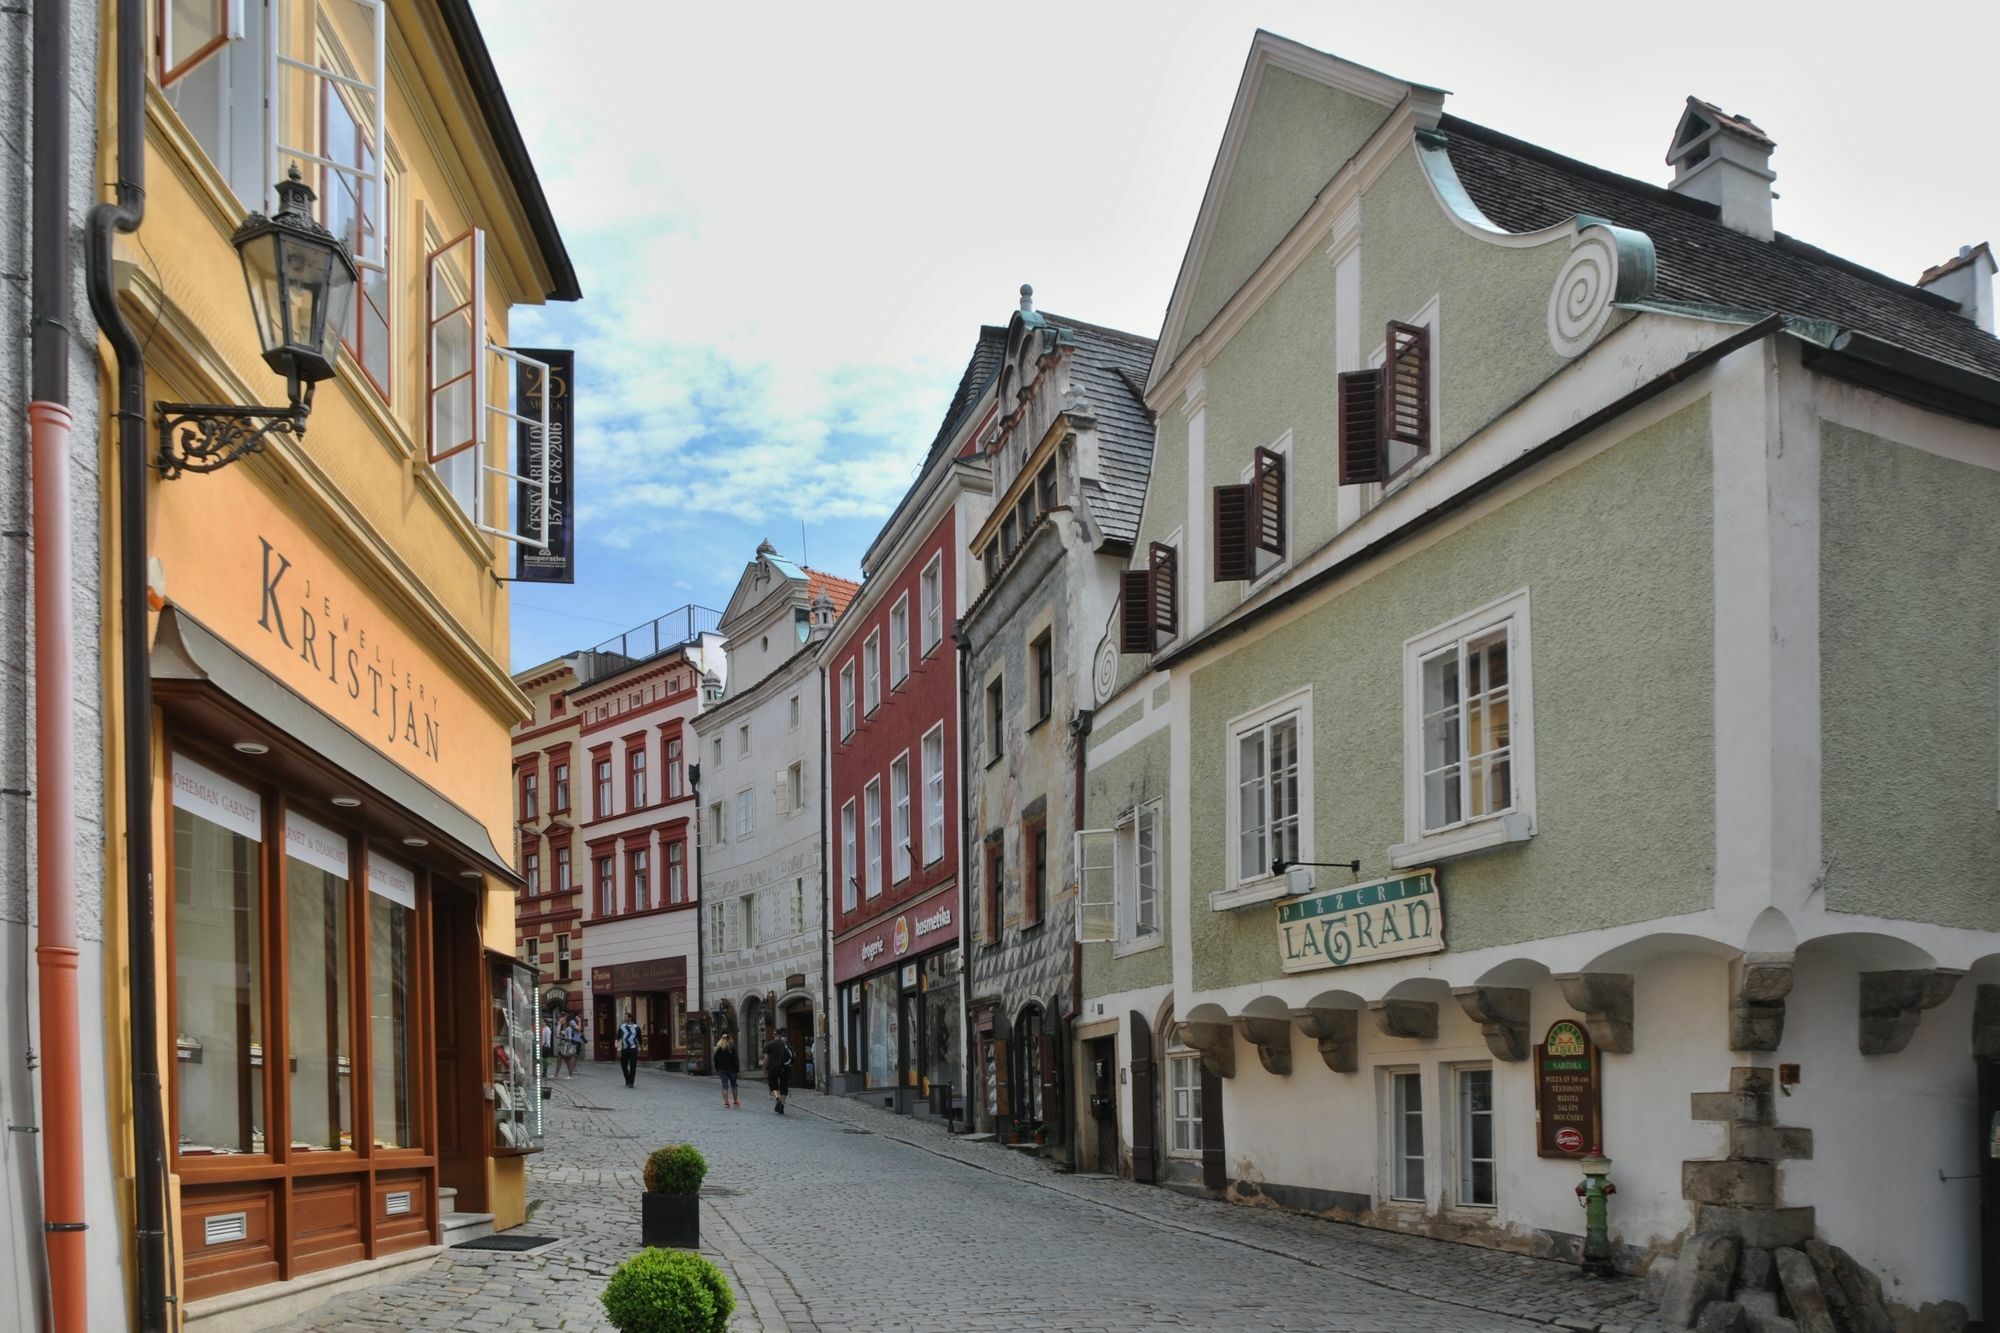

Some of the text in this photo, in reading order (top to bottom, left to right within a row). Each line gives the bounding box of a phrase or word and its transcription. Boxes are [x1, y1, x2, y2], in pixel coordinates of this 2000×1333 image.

[549, 421, 562, 484] 6/8/2016
[528, 489, 542, 531] ČESKÝ
[523, 554, 566, 563] Kooperativa
[257, 534, 440, 763] KRISTJAN
[305, 579, 438, 712] JEWELLERY
[173, 772, 256, 823] OHEMIAN GARNET
[916, 906, 951, 936] kosmetika
[1283, 876, 1428, 921] PIZZERIA
[862, 936, 884, 961] drogerie
